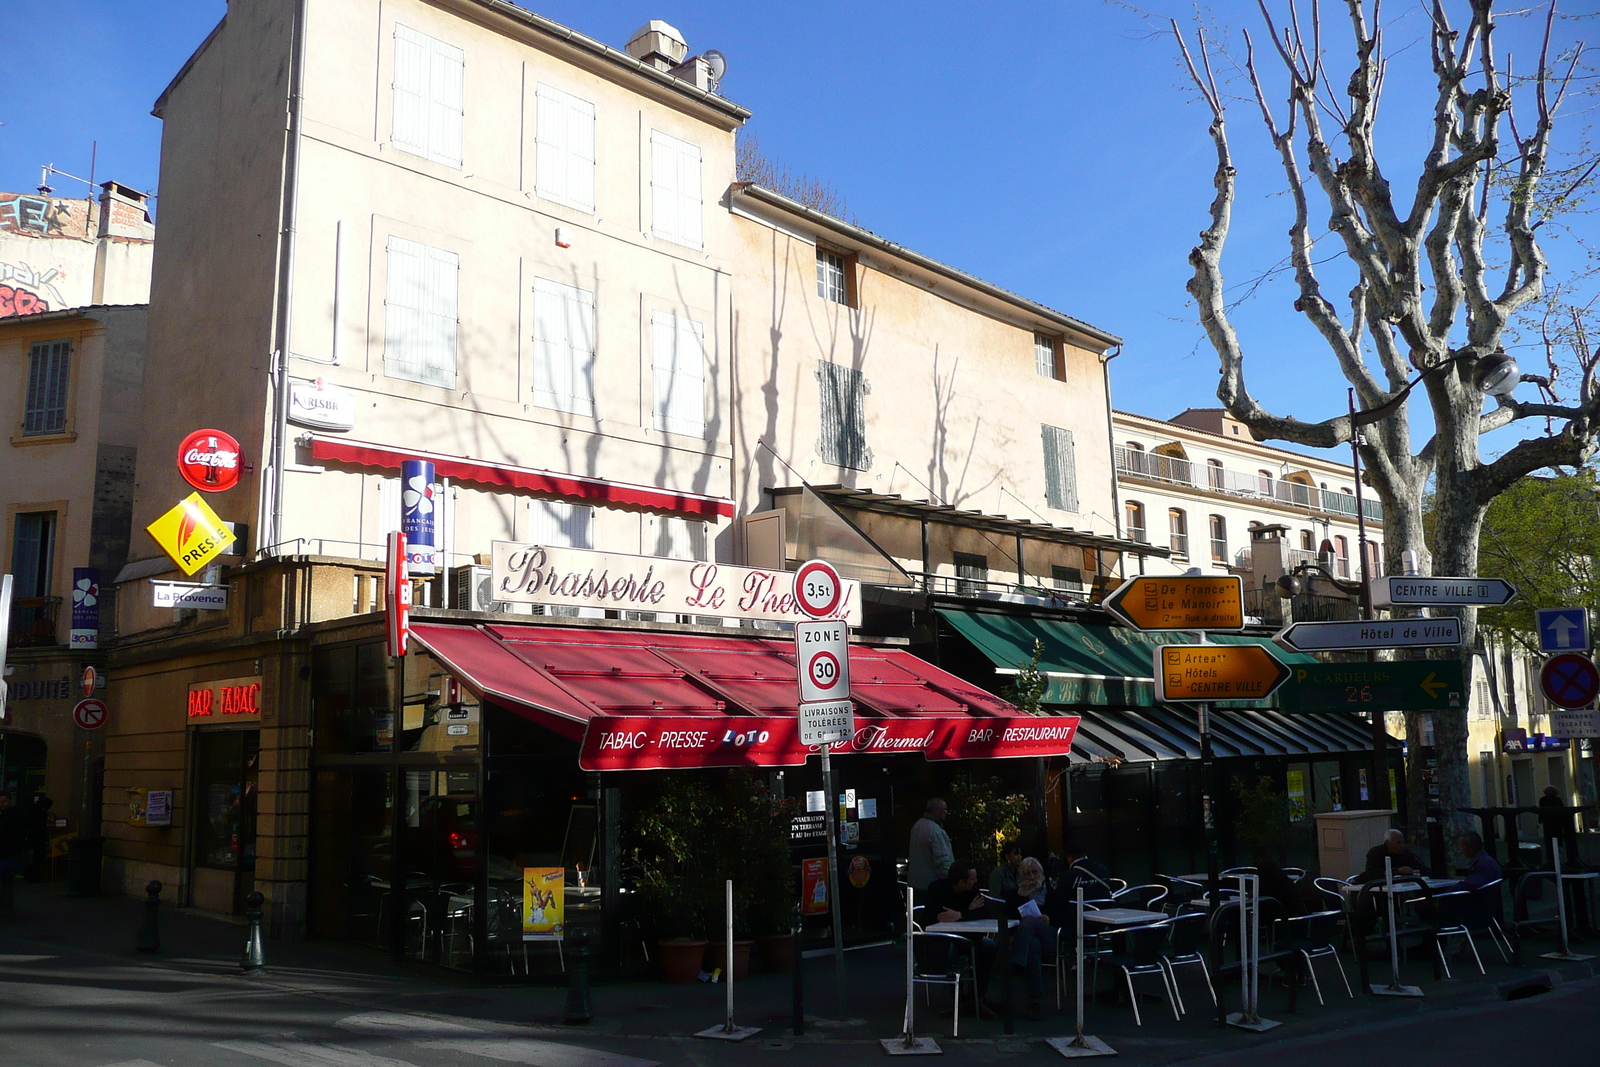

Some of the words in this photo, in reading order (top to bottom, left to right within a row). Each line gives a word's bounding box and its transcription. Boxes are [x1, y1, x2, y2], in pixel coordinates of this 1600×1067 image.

[182, 528, 227, 567] PRESSE
[500, 546, 665, 605] Brasserie
[686, 563, 725, 608] Le
[738, 570, 854, 619] Therl
[400, 536, 409, 651] TABAC
[1161, 584, 1176, 595] De
[1396, 585, 1438, 597] CENTRE
[1444, 585, 1473, 597] VILLE
[157, 591, 170, 601] La
[173, 592, 224, 604] Provence
[1162, 599, 1174, 609] Le
[1181, 599, 1221, 609] Manoir
[1185, 613, 1200, 622] Rue
[804, 629, 841, 643] ZONE
[1361, 627, 1394, 640] Hôtel
[1403, 626, 1418, 638] de
[1424, 624, 1453, 638] Ville
[1184, 653, 1217, 664] Artea
[814, 662, 834, 679] 30
[1185, 668, 1218, 678] Hôtels
[1314, 671, 1391, 683] CARDEURS
[1236, 681, 1262, 692] VILLE
[189, 688, 214, 717] BAR
[219, 683, 261, 715] TABAC
[804, 706, 849, 717] LIVRAISONS
[807, 716, 847, 728] TOLÉRÉES
[600, 731, 647, 750] TABAC
[658, 730, 708, 749] PRESSE
[721, 728, 770, 747] LOTO
[804, 732, 813, 740] DE
[851, 725, 935, 751] Thermal
[967, 728, 993, 743] BAR
[1002, 726, 1071, 741] RESTAURANT
[1503, 739, 1524, 750] AXA
[791, 824, 799, 832] EN
[795, 831, 804, 839] AU
